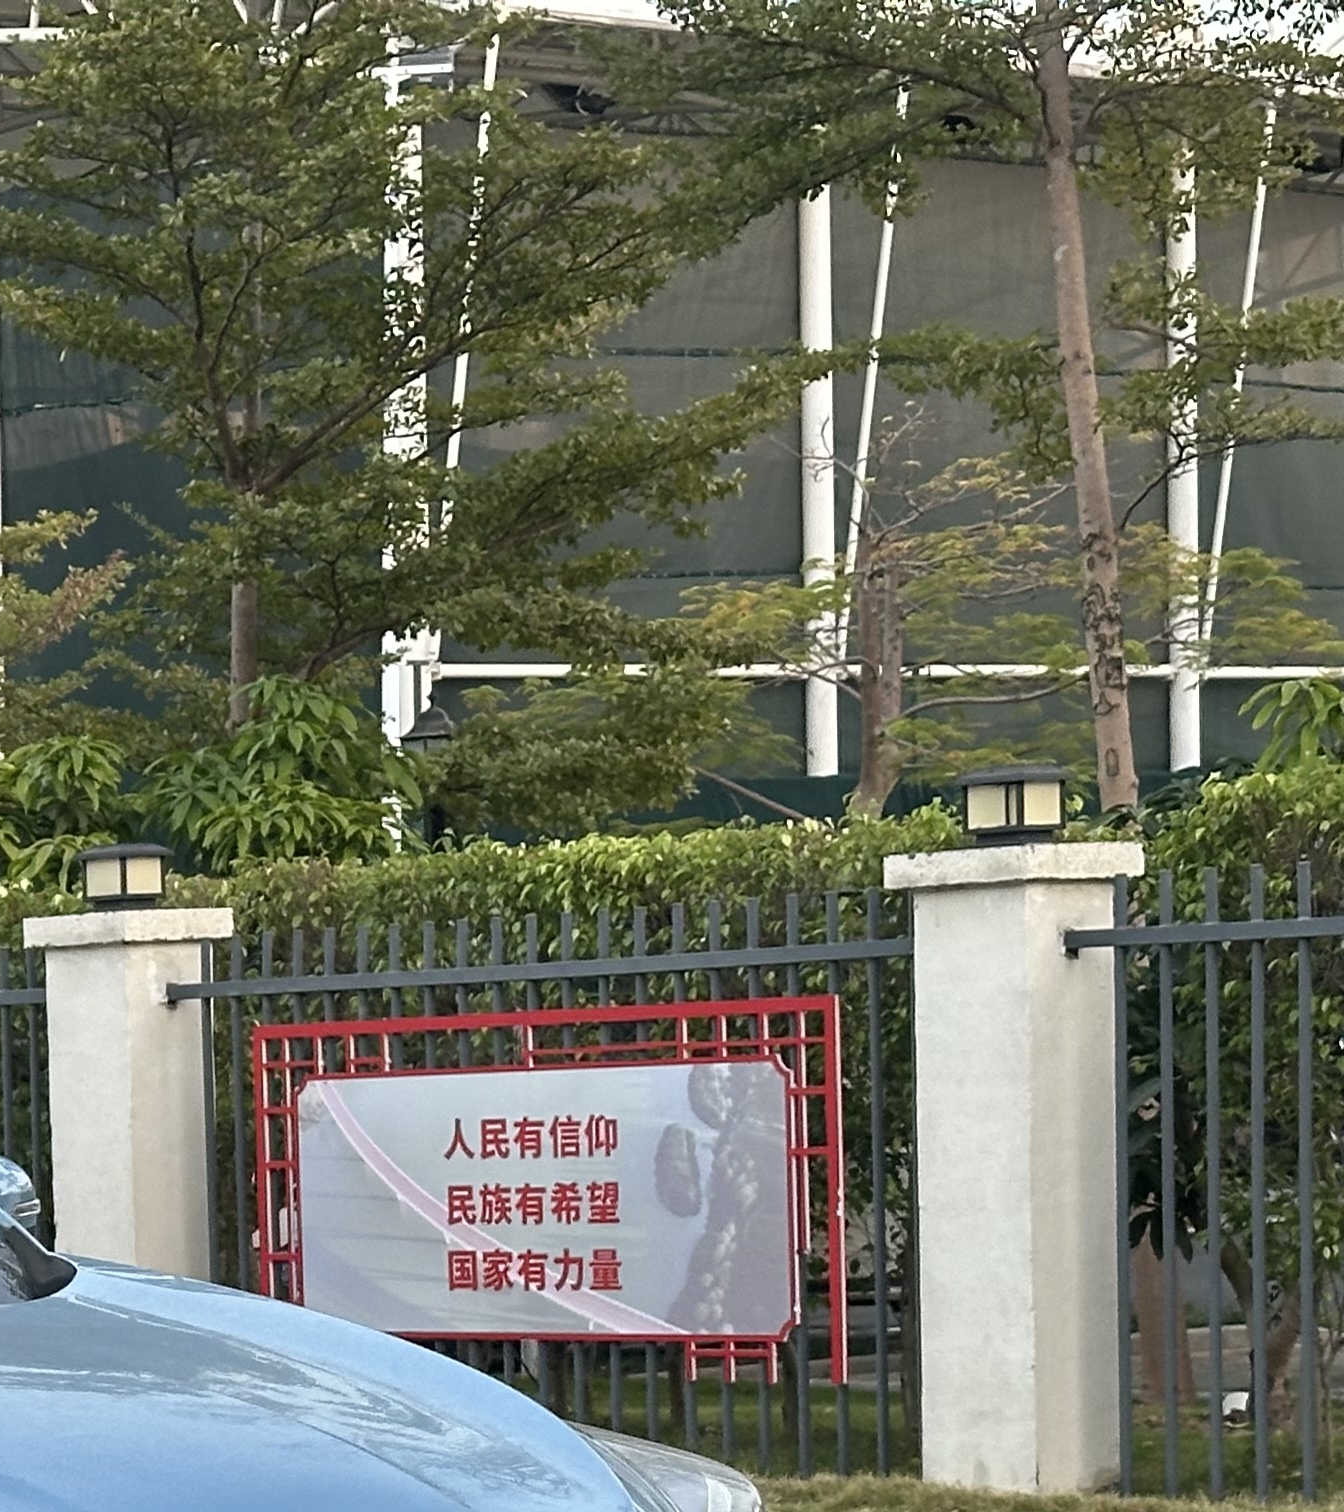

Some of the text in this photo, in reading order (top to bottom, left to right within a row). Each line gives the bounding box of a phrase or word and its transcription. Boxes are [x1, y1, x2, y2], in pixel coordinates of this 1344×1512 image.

[444, 1114, 618, 1160] 人民有信仰
[447, 1181, 620, 1226] 民族有希望
[448, 1248, 623, 1292] 国家有力量
